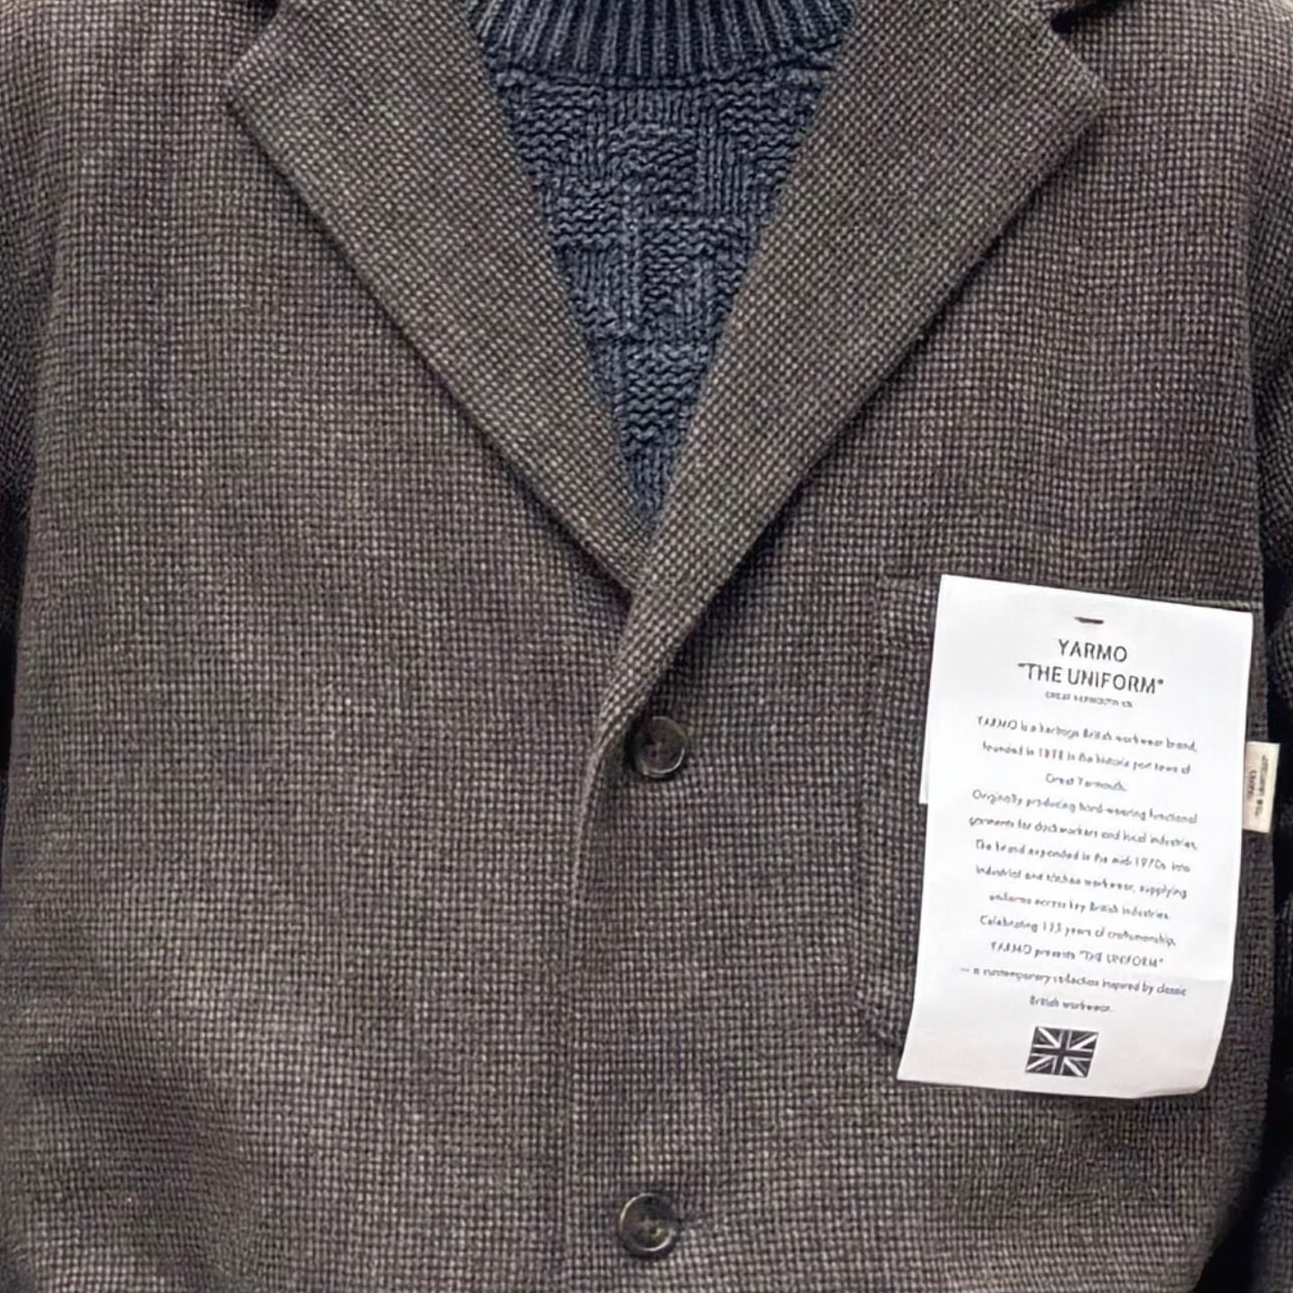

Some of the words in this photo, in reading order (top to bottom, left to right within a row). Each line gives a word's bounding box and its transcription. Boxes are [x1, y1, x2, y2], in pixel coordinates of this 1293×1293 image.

[1058, 638, 1128, 663] YARMO
[978, 715, 1018, 730] YARMO
[1021, 720, 1028, 732] is
[1030, 725, 1037, 733] a
[1039, 722, 1079, 739] heritage
[1083, 728, 1112, 741] British
[1115, 733, 1163, 747] workwear
[982, 740, 1023, 756] founded
[1026, 747, 1034, 756] in
[1067, 751, 1075, 761] in
[1078, 752, 1093, 763] the
[1095, 754, 1129, 768] historic
[1133, 761, 1152, 771] port
[1154, 762, 1178, 773] town
[1181, 764, 1191, 775] of
[1045, 773, 1074, 786] Great
[972, 789, 1023, 806] Originally
[1026, 797, 1076, 813] producing
[1149, 808, 1198, 824] functional
[969, 816, 1014, 828] garments
[1018, 818, 1032, 830] for
[1101, 830, 1120, 840] and
[1123, 830, 1147, 843] local
[976, 839, 992, 851] The
[995, 841, 1026, 854] brand
[1028, 848, 1079, 860] expanded
[1082, 851, 1090, 861] in
[1094, 852, 1108, 864] the
[1171, 861, 1190, 872] into
[976, 864, 1022, 879] industrial
[1025, 872, 1043, 881] and
[1046, 873, 1081, 885] kitchen
[1139, 884, 1187, 900] supplying
[989, 891, 1032, 905] uniforms
[1034, 898, 1066, 909] across
[1069, 899, 1086, 914] key
[1089, 901, 1119, 914] British
[980, 915, 1038, 933] Celebrating
[1065, 927, 1091, 937] years
[1095, 926, 1105, 938] of
[991, 941, 1032, 955] YARMO
[1034, 949, 1075, 960] presents
[973, 967, 980, 975] a
[983, 969, 1051, 986] contemporary
[1053, 973, 1099, 987] collection
[1102, 978, 1141, 992] inspired
[1142, 981, 1153, 996] by
[1156, 983, 1186, 996] classic
[1029, 994, 1060, 1008] British
